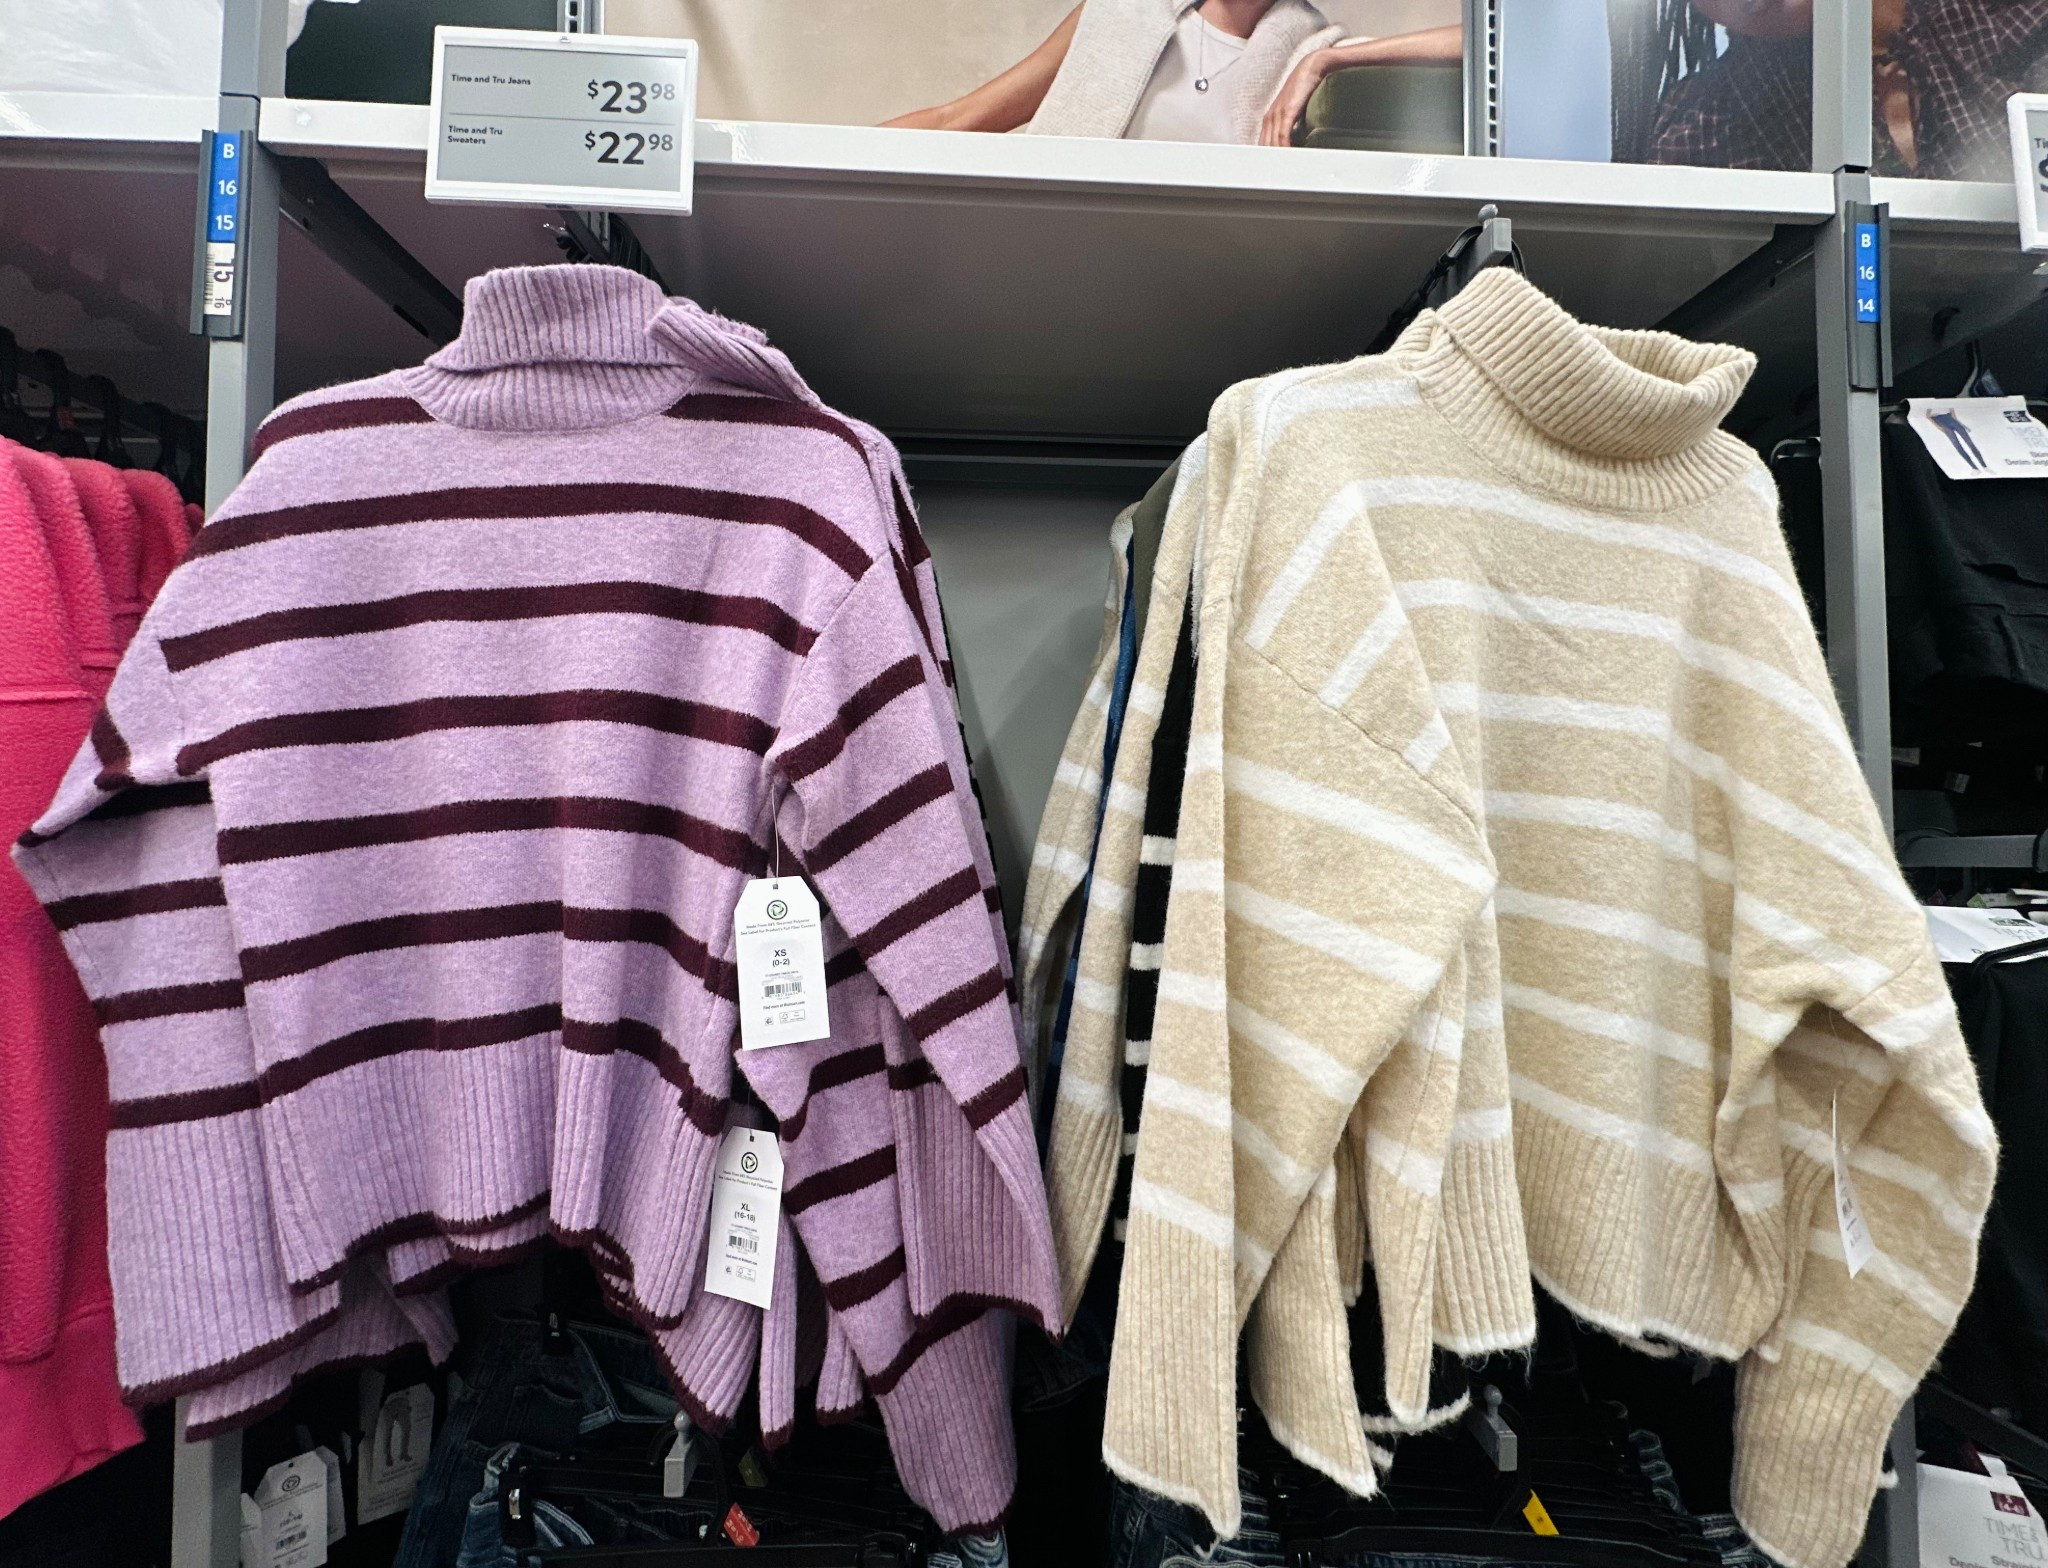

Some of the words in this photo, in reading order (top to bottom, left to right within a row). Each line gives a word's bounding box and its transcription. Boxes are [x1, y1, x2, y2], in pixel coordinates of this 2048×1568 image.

[452, 74, 472, 82] Time
[508, 77, 531, 85] Jeans
[448, 125, 469, 133] Time
[471, 126, 487, 134] and
[490, 127, 503, 135] Tru
[447, 135, 486, 144] Sweaters
[223, 143, 235, 159] B
[218, 180, 237, 195] 16
[215, 215, 234, 230] 15
[1861, 233, 1872, 248] B
[1859, 265, 1875, 280] 16
[1857, 298, 1875, 313] 14
[774, 949, 787, 958] XS
[772, 958, 790, 968] (0-2)
[740, 1202, 750, 1212] XL
[734, 1211, 756, 1223] (16-18)
[1983, 1516, 2029, 1541] TIME
[2000, 1536, 2045, 1561] TRU
